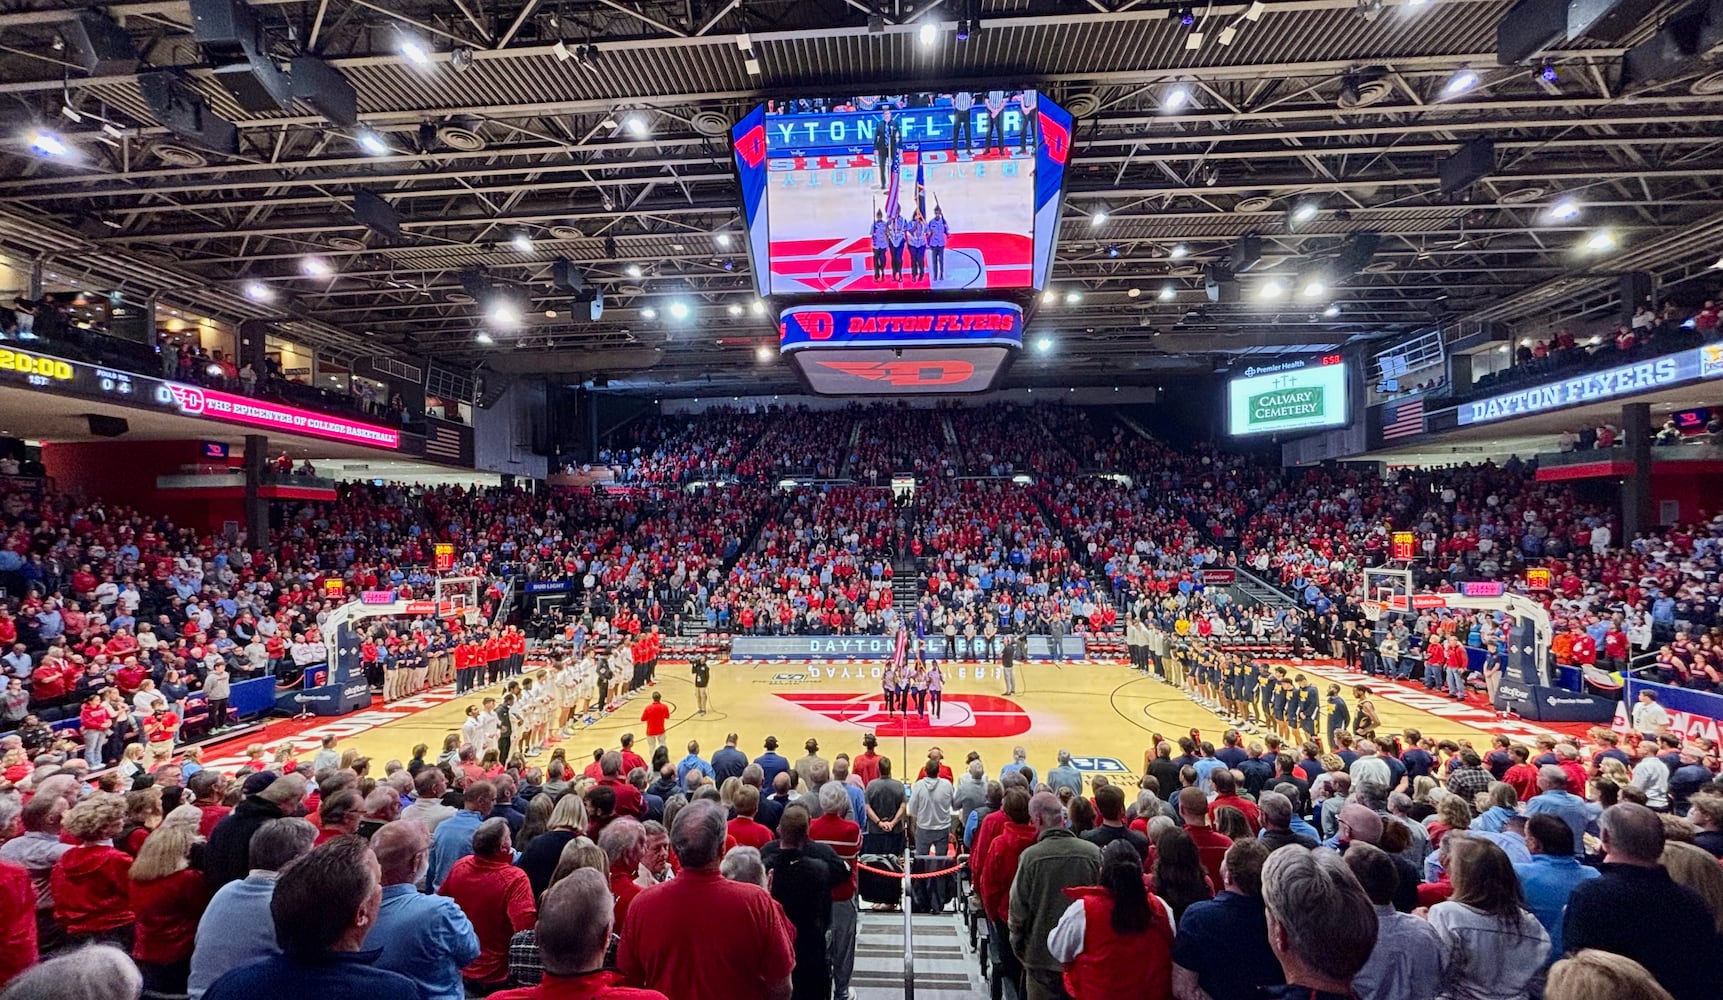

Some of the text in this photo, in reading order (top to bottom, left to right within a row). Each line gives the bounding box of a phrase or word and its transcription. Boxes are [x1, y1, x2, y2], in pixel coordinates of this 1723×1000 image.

[848, 315, 1014, 333] DAYTON FLYERS
[1256, 360, 1304, 374] Premier Health
[1471, 358, 1677, 421] DAYTON FLYERS
[1259, 391, 1312, 407] CALVARY
[206, 398, 231, 412] THE
[232, 403, 292, 424] EPICENTER
[294, 415, 307, 426] OF
[307, 418, 346, 434] COLLEGE
[1255, 402, 1317, 419] CEMETERY
[811, 640, 895, 652] DAYTON
